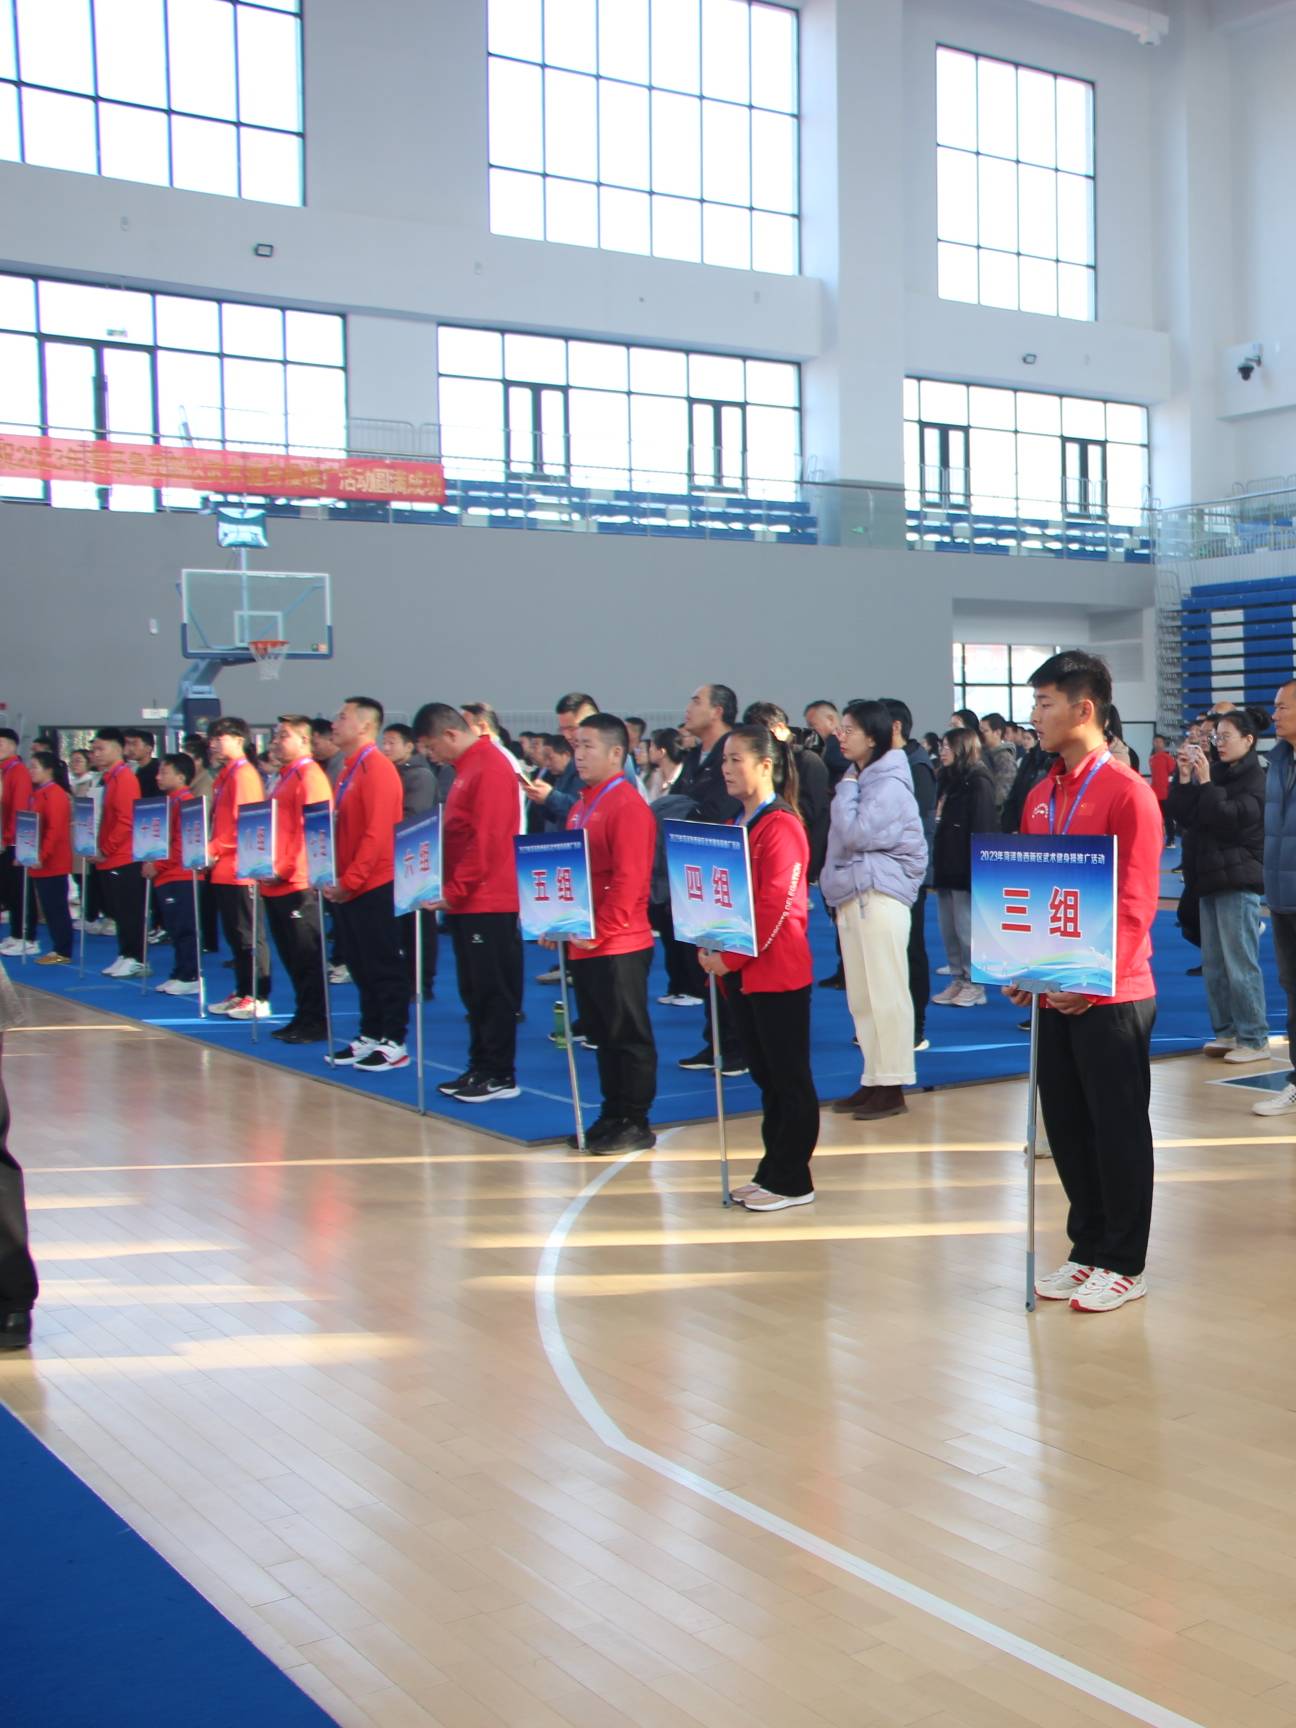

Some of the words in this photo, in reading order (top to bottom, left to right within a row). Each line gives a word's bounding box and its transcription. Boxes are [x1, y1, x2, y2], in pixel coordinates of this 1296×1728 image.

[532, 867, 575, 902] 五组
[684, 864, 733, 910] 四组
[1001, 886, 1081, 939] 三组
